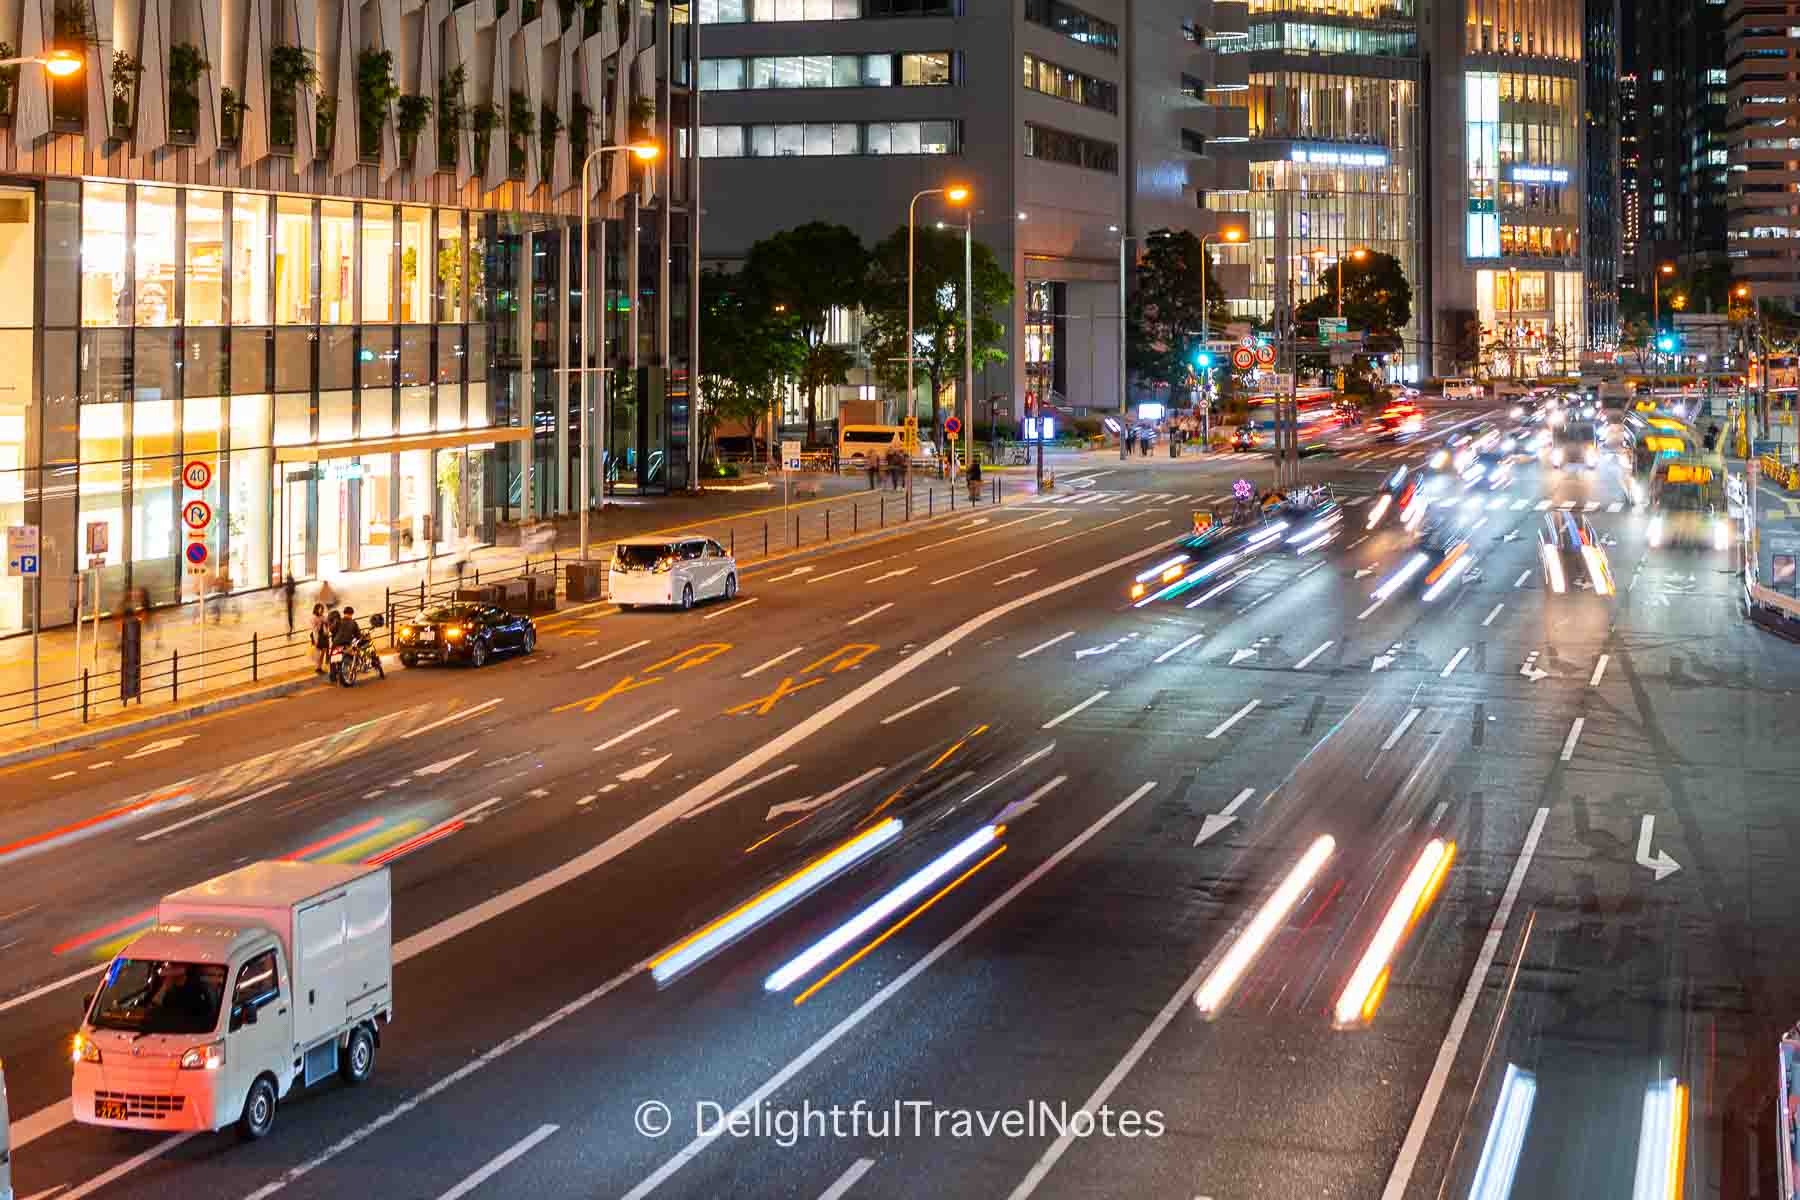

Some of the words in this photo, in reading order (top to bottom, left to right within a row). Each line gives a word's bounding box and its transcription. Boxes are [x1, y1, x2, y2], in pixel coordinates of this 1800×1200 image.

[1238, 353, 1250, 363] 40
[190, 469, 205, 482] 40
[24, 558, 34, 572] P
